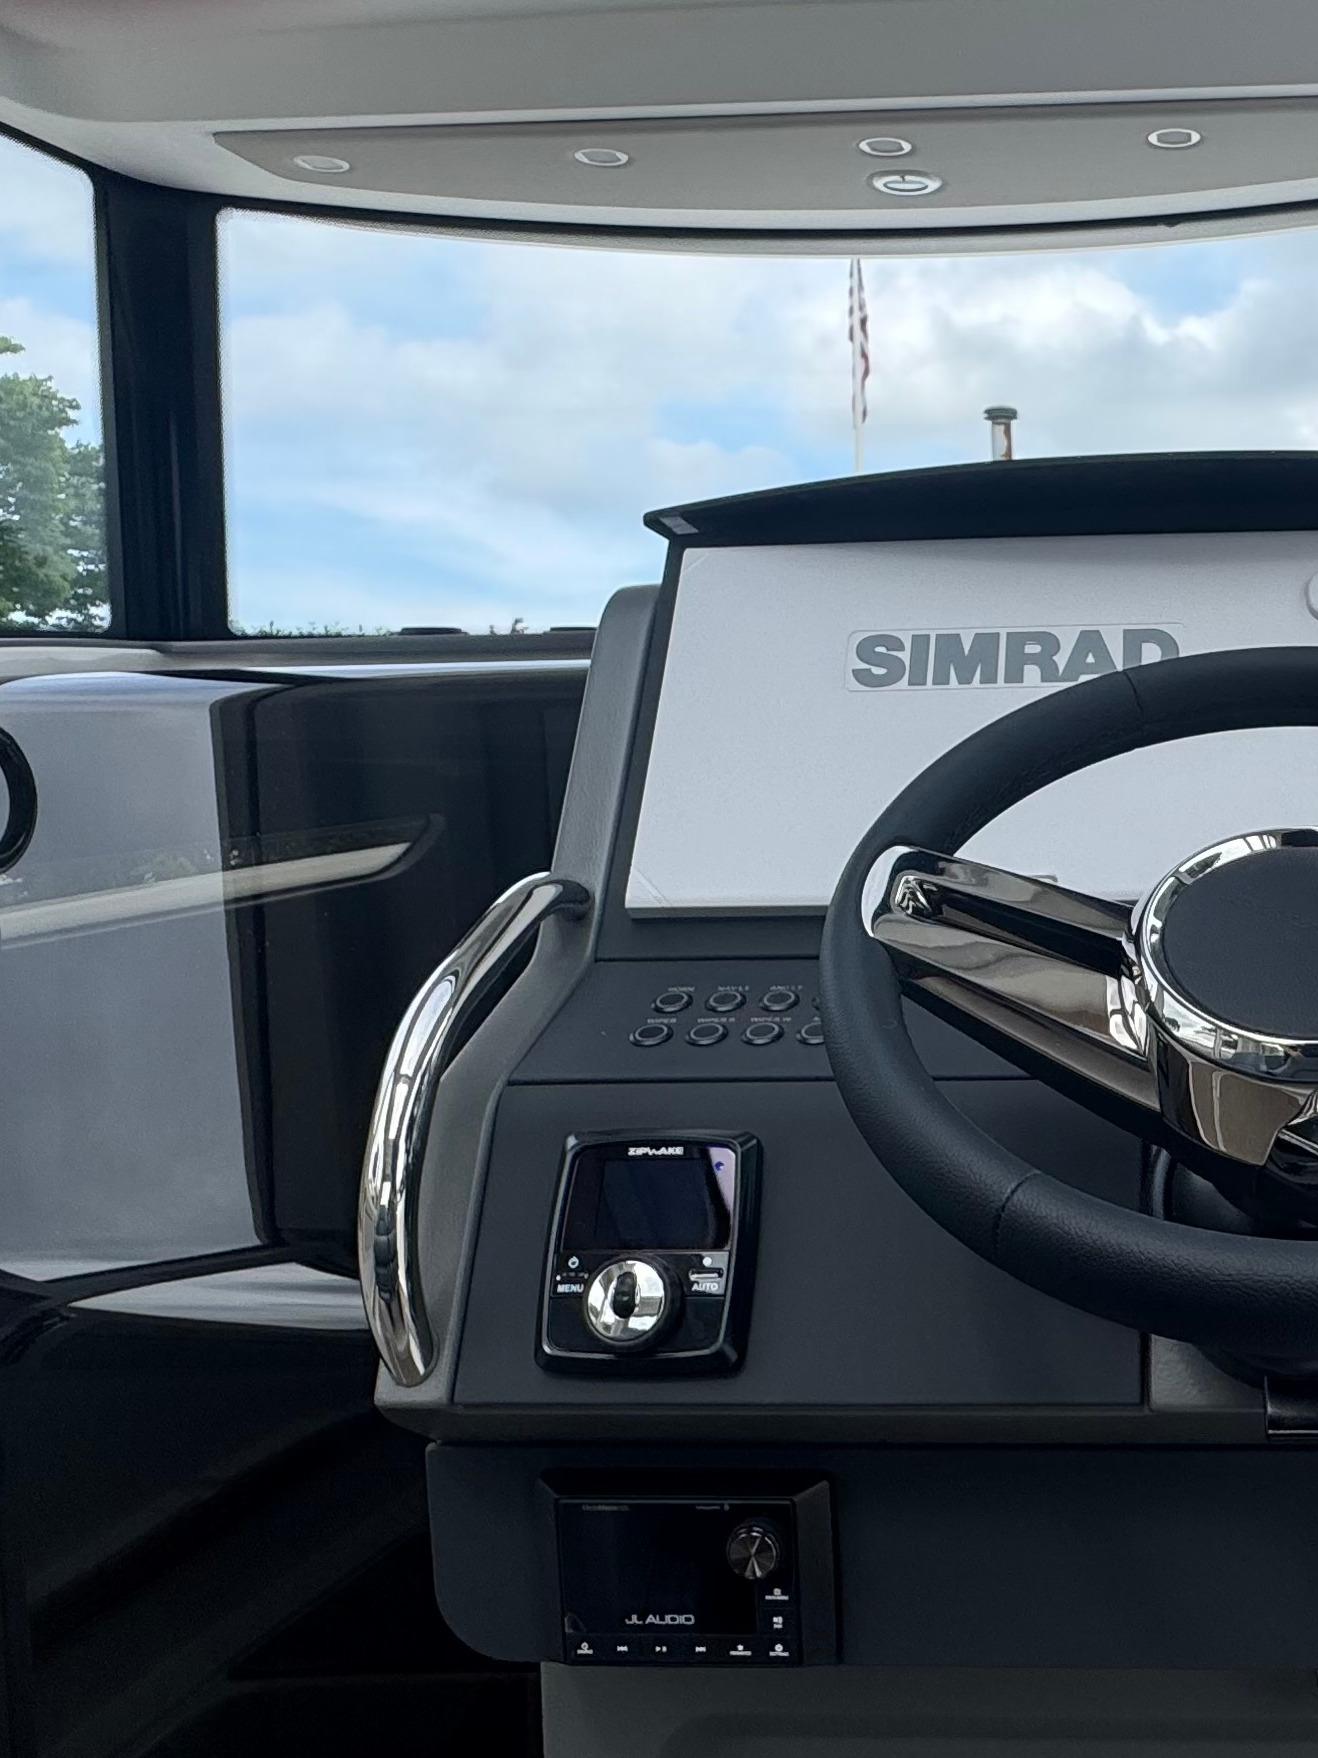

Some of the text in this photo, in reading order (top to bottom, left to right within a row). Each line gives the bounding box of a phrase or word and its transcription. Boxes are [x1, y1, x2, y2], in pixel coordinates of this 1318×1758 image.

[852, 628, 1181, 688] SIMRAD
[556, 1283, 585, 1294] MENU
[691, 1281, 719, 1292] AUTO
[625, 1614, 695, 1625] JL AUDIO
